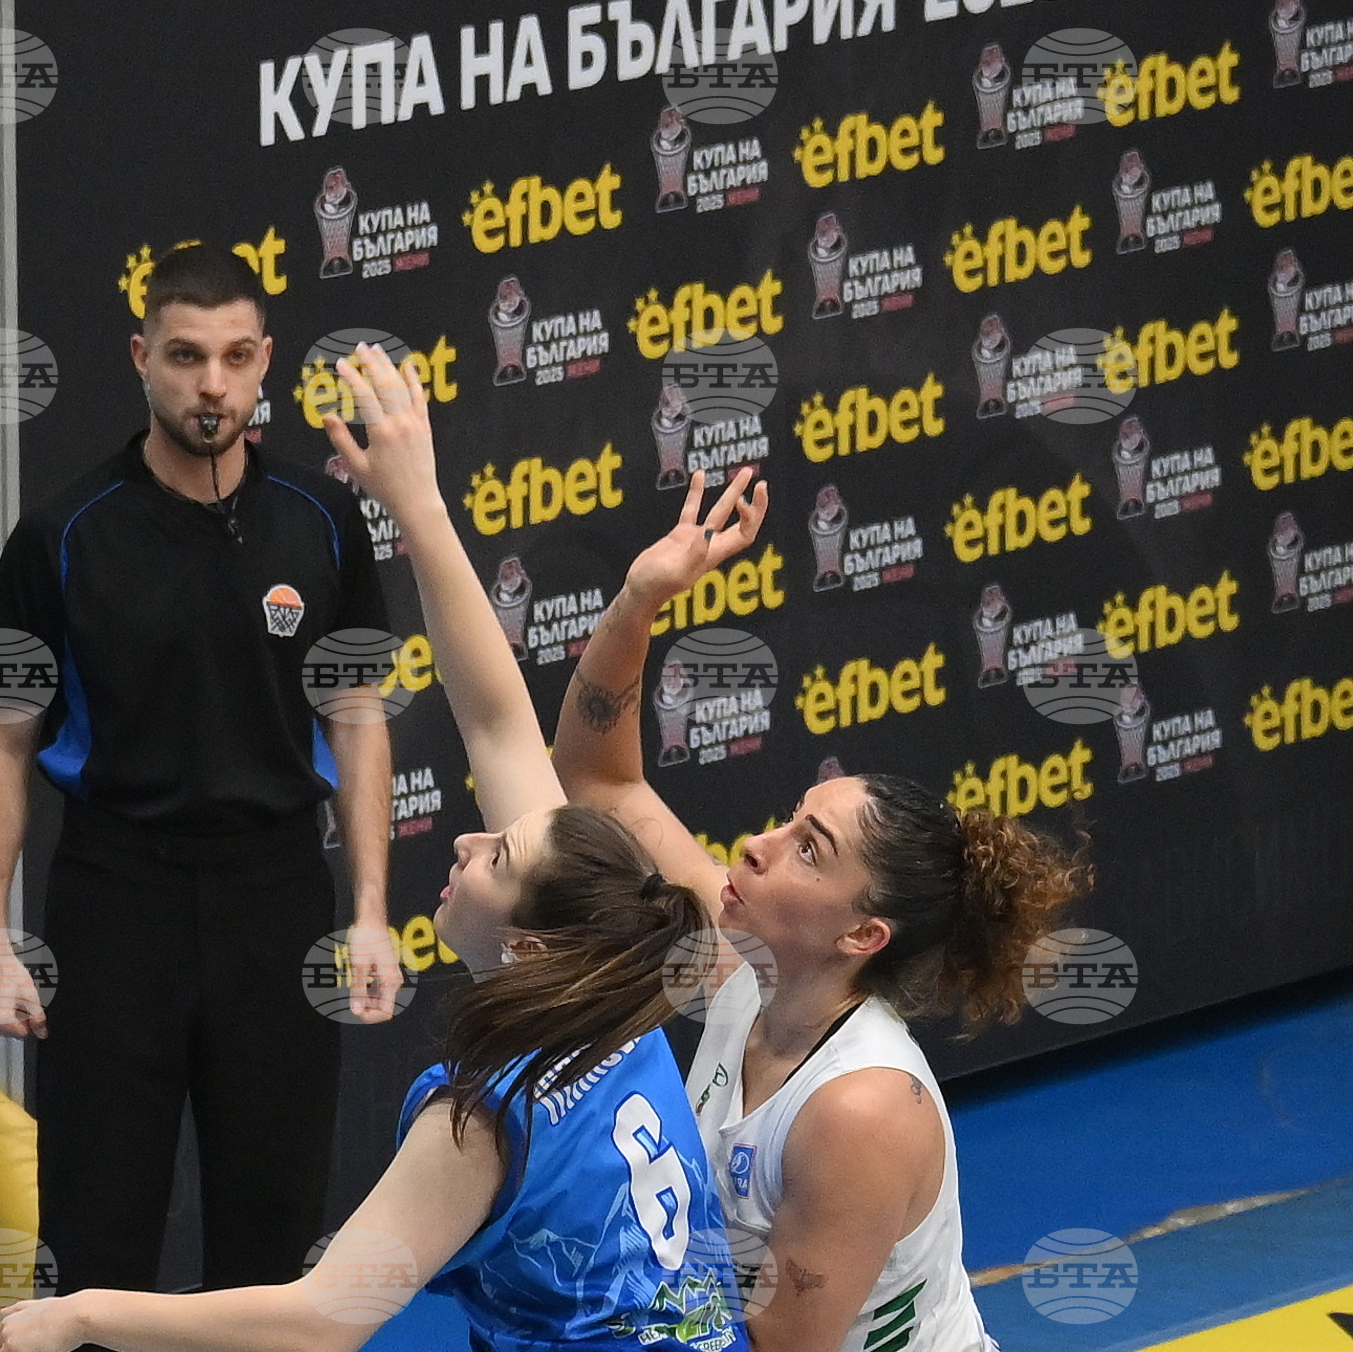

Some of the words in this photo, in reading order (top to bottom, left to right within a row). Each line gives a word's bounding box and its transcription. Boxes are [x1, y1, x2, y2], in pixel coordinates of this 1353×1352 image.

[258, 36, 446, 147] КУПА
[459, 13, 554, 110] НА
[1104, 42, 1240, 127] efbet
[693, 144, 736, 171] КУПА
[738, 138, 762, 162] НА
[799, 102, 945, 189] efbet
[687, 160, 768, 196] БЪЛГАРИЯ
[1251, 155, 1353, 228] efbe
[359, 207, 404, 235] КУПА
[407, 201, 431, 226] НА
[469, 163, 623, 254] efbet
[352, 224, 438, 262] БЪЛГАРИЯ
[849, 251, 891, 278] КУПА
[893, 245, 915, 269] НА
[951, 205, 1093, 294] efbet
[844, 267, 923, 302] БЪЛГАРИЯ
[532, 313, 576, 343] КУПА
[578, 309, 602, 333] НА
[634, 269, 784, 360] efbet
[527, 332, 609, 369] БЪЛГАРИЯ
[1105, 308, 1239, 394] efbet
[302, 336, 458, 429] efet
[694, 421, 736, 448] КУПА
[739, 414, 762, 438] НА
[800, 373, 945, 463] efbet
[687, 436, 769, 474] БЪЛГАРИЯ
[1251, 417, 1353, 491] efbe
[470, 442, 624, 536] efbet
[849, 521, 891, 551] КУПА
[894, 516, 916, 540] НА
[952, 473, 1092, 563] efbet
[844, 537, 923, 576] БЪЛГАРИЯ
[528, 612, 606, 649] БЪЛГАРИ
[534, 594, 578, 623] КУПА
[580, 588, 603, 612] НА
[1103, 570, 1240, 659] efbet
[696, 696, 739, 724] КУПА
[741, 689, 763, 712] НА
[801, 642, 946, 735] efbet
[1251, 678, 1353, 751] efbe
[689, 709, 770, 749] БЪЛГАРИЯ
[410, 767, 434, 792] НА
[612, 1091, 692, 1271] 6
